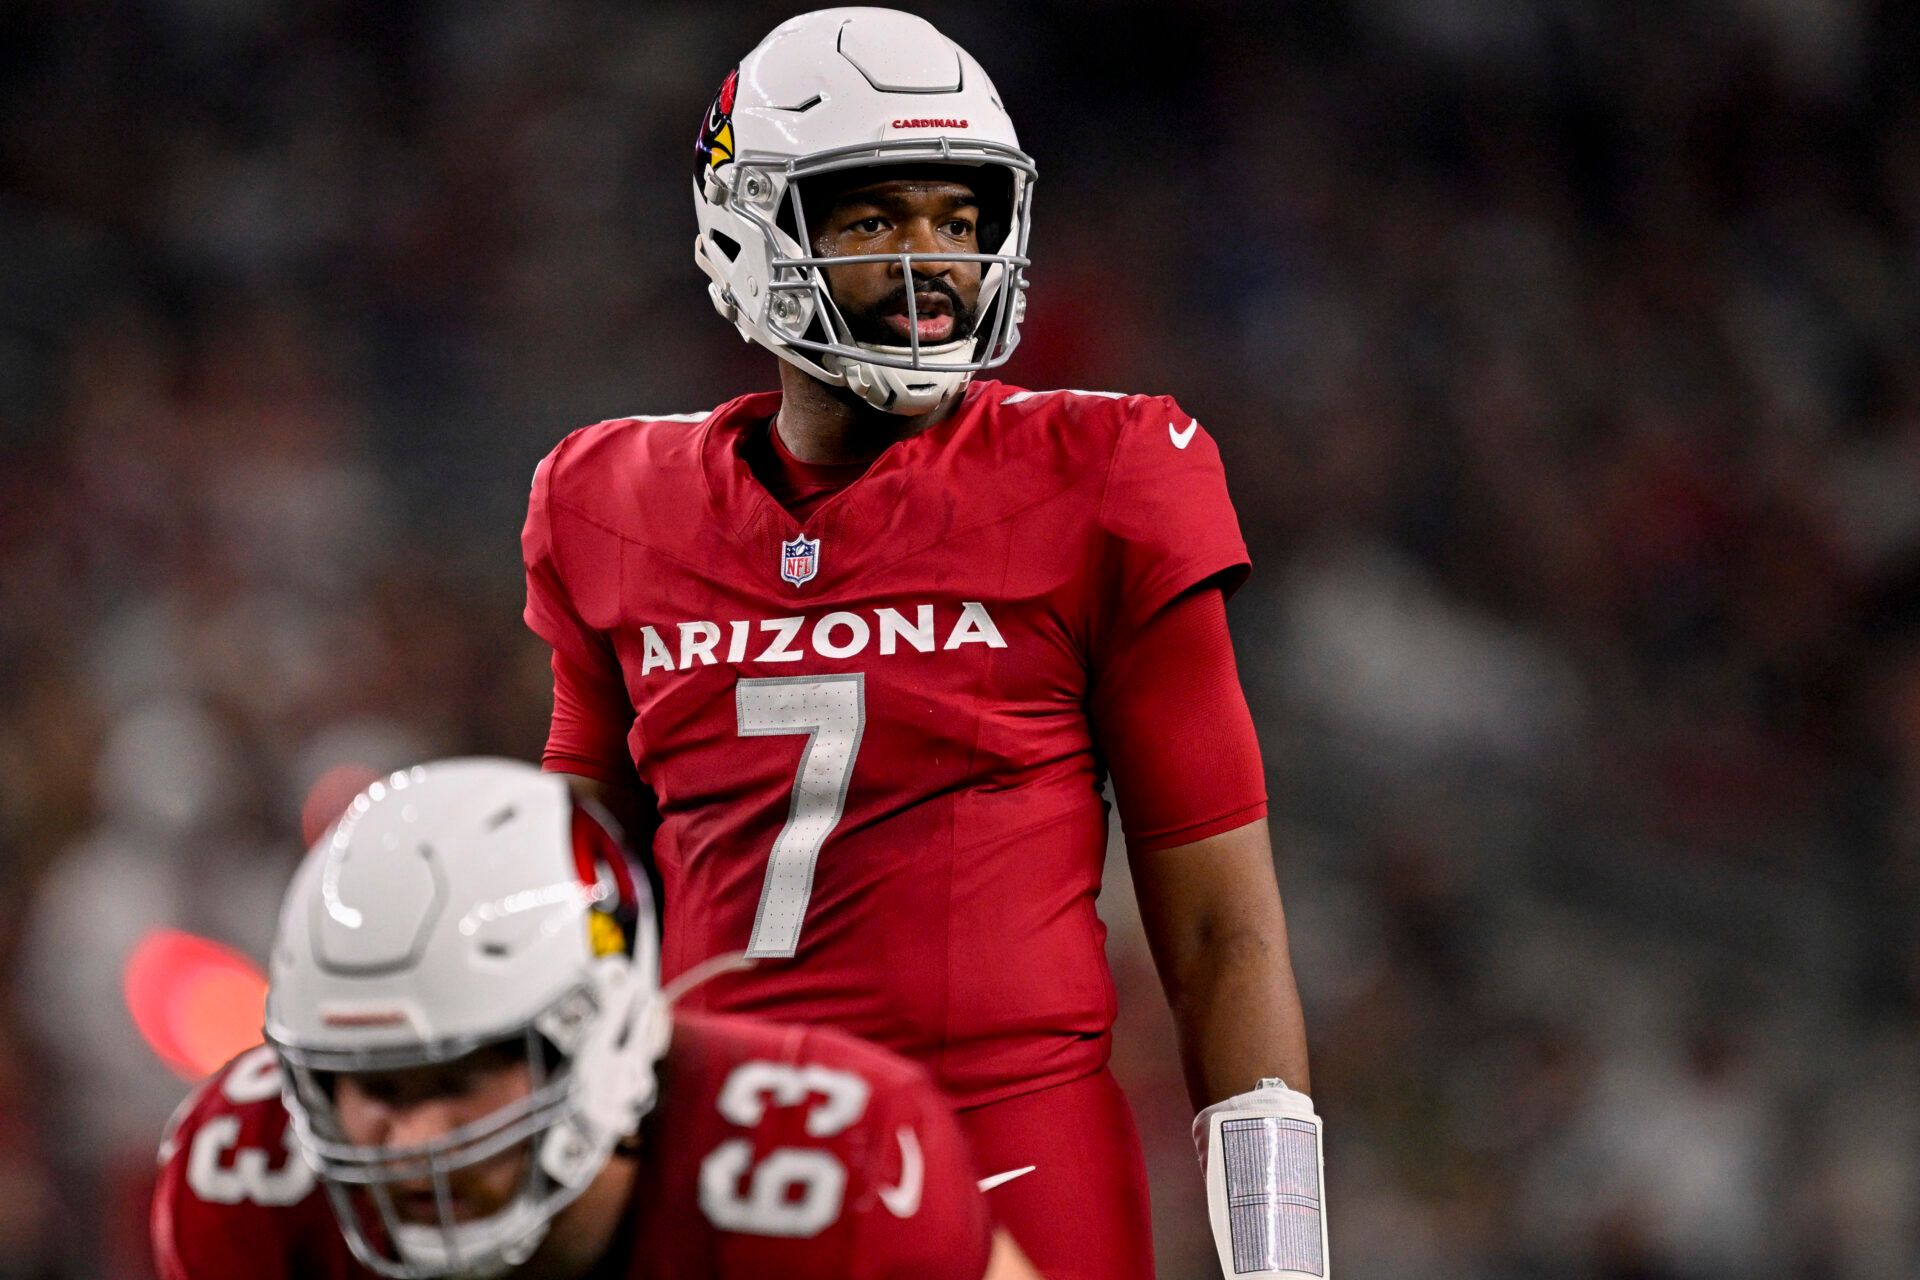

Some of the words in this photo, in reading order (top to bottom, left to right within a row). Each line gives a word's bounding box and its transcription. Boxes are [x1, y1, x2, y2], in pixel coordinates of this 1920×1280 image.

[892, 119, 968, 129] CARDINALS
[786, 557, 811, 577] NFL
[640, 602, 1008, 676] ARIZONA
[736, 672, 866, 959] 7
[698, 1060, 871, 1240] 63
